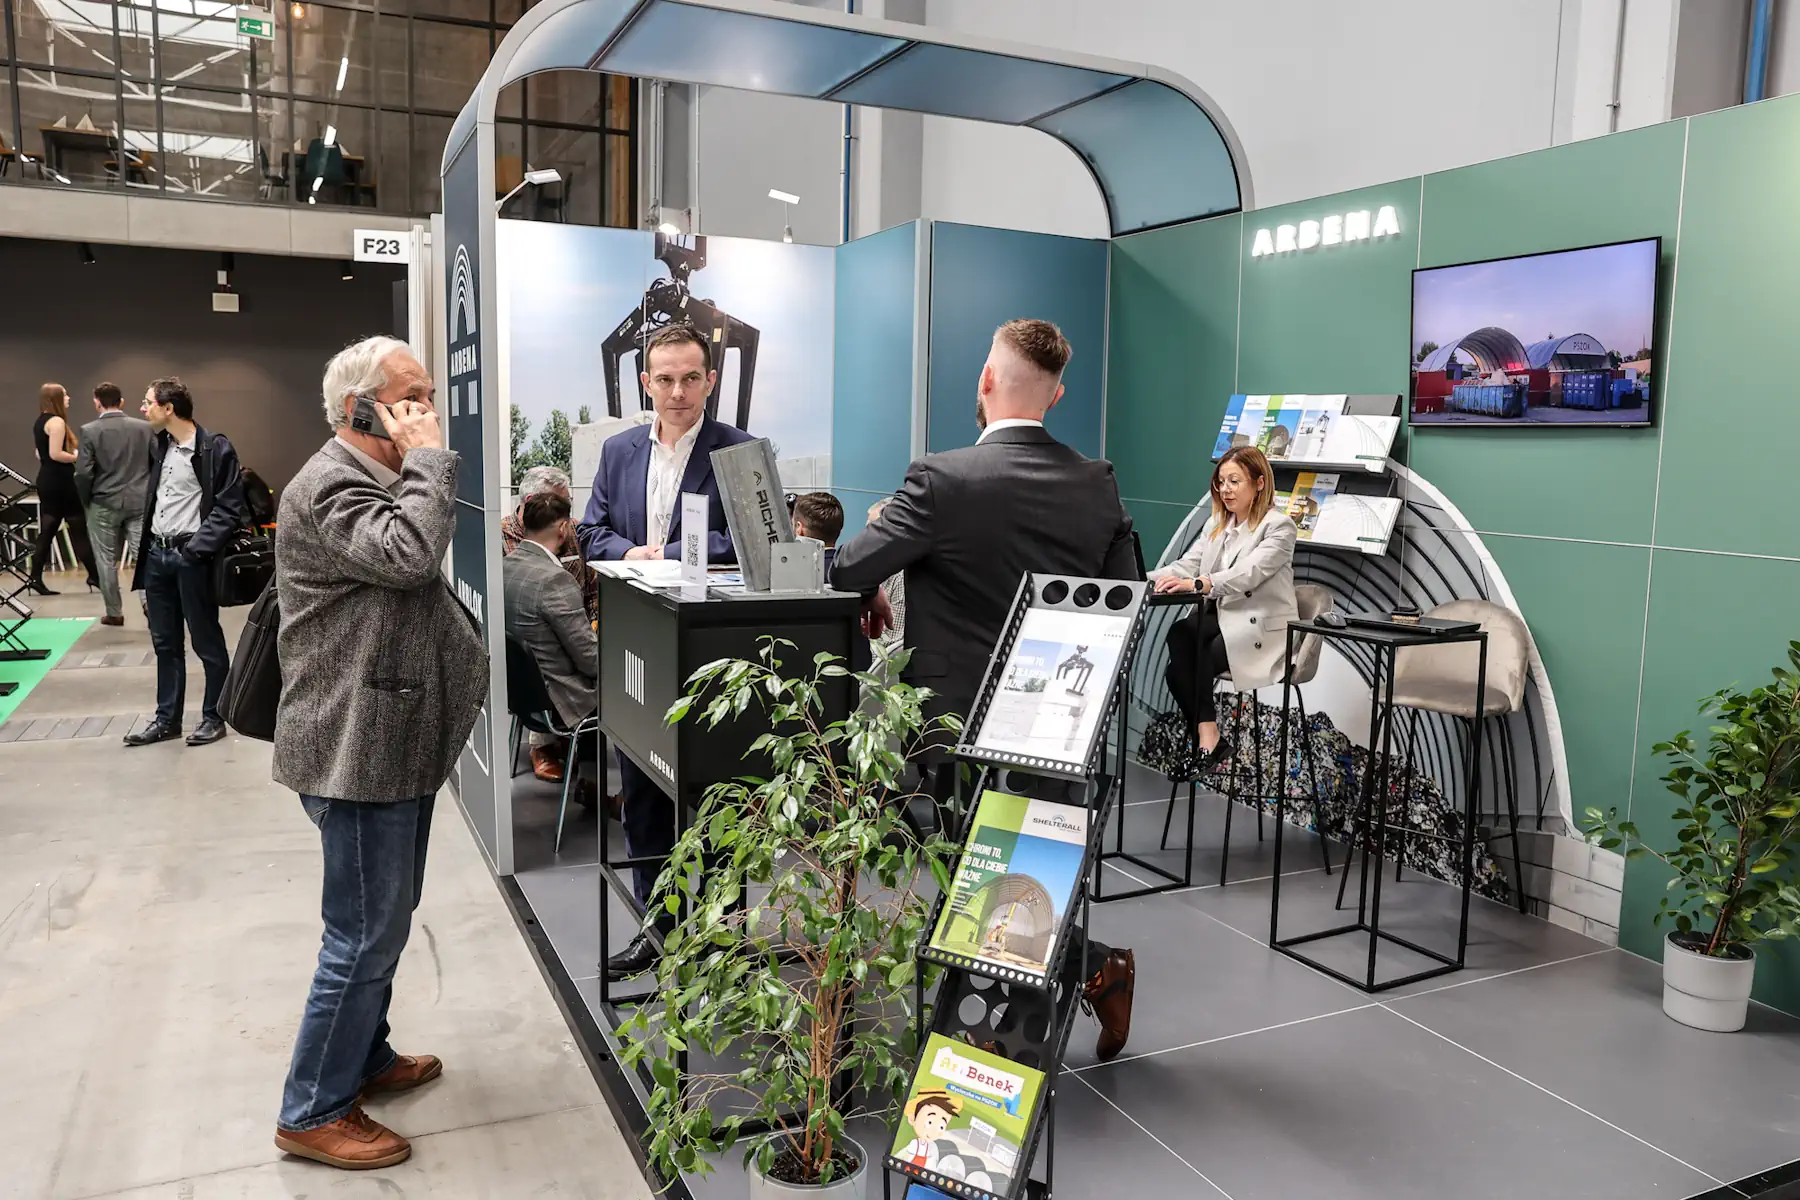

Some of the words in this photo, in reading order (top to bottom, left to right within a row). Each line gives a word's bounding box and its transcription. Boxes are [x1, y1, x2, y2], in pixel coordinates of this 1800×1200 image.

[1252, 205, 1400, 257] ARBENA
[363, 238, 400, 255] F23
[451, 344, 477, 378] ARBENA
[650, 750, 675, 783] ARBENA
[1033, 817, 1082, 832] SHELTERALL
[966, 1065, 1014, 1093] Benek
